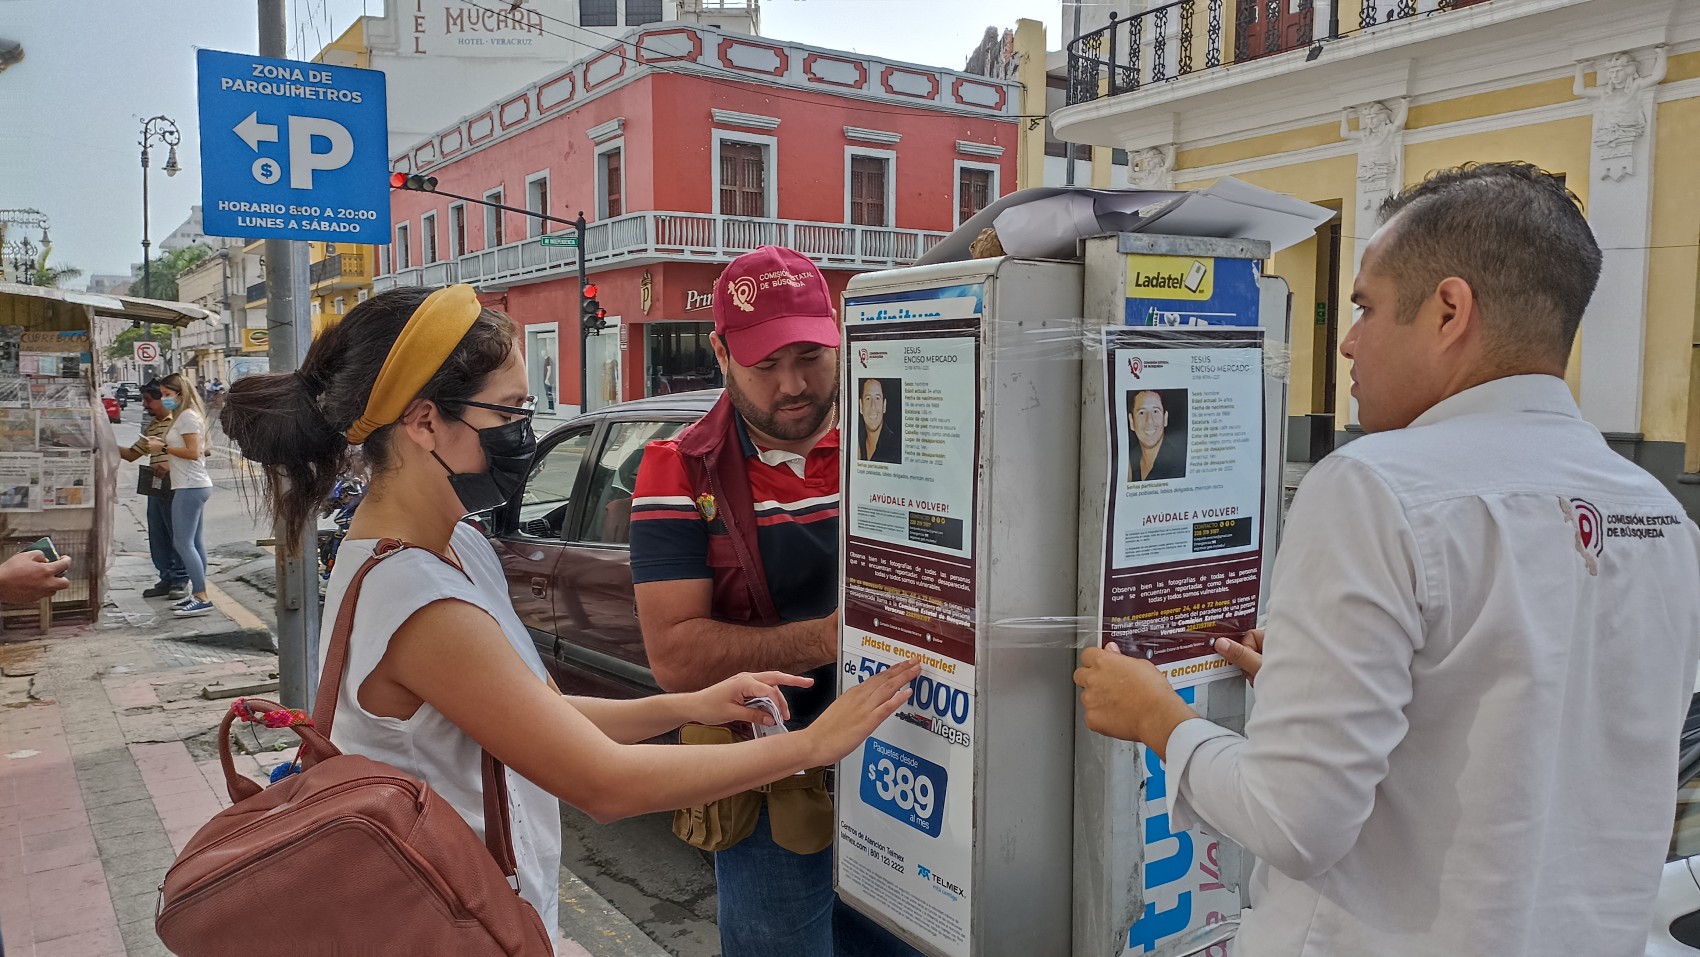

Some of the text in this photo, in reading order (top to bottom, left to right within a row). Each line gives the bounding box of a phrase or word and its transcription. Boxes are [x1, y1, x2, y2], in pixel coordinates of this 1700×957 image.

[252, 64, 332, 84] ZONA DE
[221, 78, 362, 104] PARQUÍMETROS
[288, 115, 354, 190] P
[218, 200, 377, 220] HORARIO 8:00 A 20:00
[238, 216, 360, 233] LUNES A SÁBADO
[1135, 271, 1184, 289] Ladatel
[926, 355, 957, 363] MERCADO
[870, 493, 905, 507] ¡AYÚDALE
[916, 500, 949, 513] VOLVER!
[1142, 506, 1239, 526] ¡AYÚDALE A VOLVER!
[1607, 514, 1681, 525] COMISIÓN ESTATAL
[1607, 526, 1664, 539] DE BÚSQUEDA
[1112, 585, 1136, 594] Observa
[1168, 576, 1196, 587] fotografías
[1140, 587, 1170, 598] encuentran
[1175, 583, 1203, 593] reportadas
[1148, 595, 1162, 604] todas
[1167, 593, 1182, 601] todos
[1160, 607, 1181, 616] esperar
[1199, 607, 1222, 617] paradero
[861, 636, 956, 674] ¡Hasta encontrarles!
[844, 660, 856, 675] de
[931, 716, 970, 747] Megas
[873, 741, 918, 768] Paquetes desde
[910, 814, 930, 829] al mes
[841, 820, 858, 837] Centros
[887, 846, 904, 862] Telmex
[840, 831, 867, 853] telmex.com
[870, 848, 880, 860] 800
[891, 860, 904, 874] 2222
